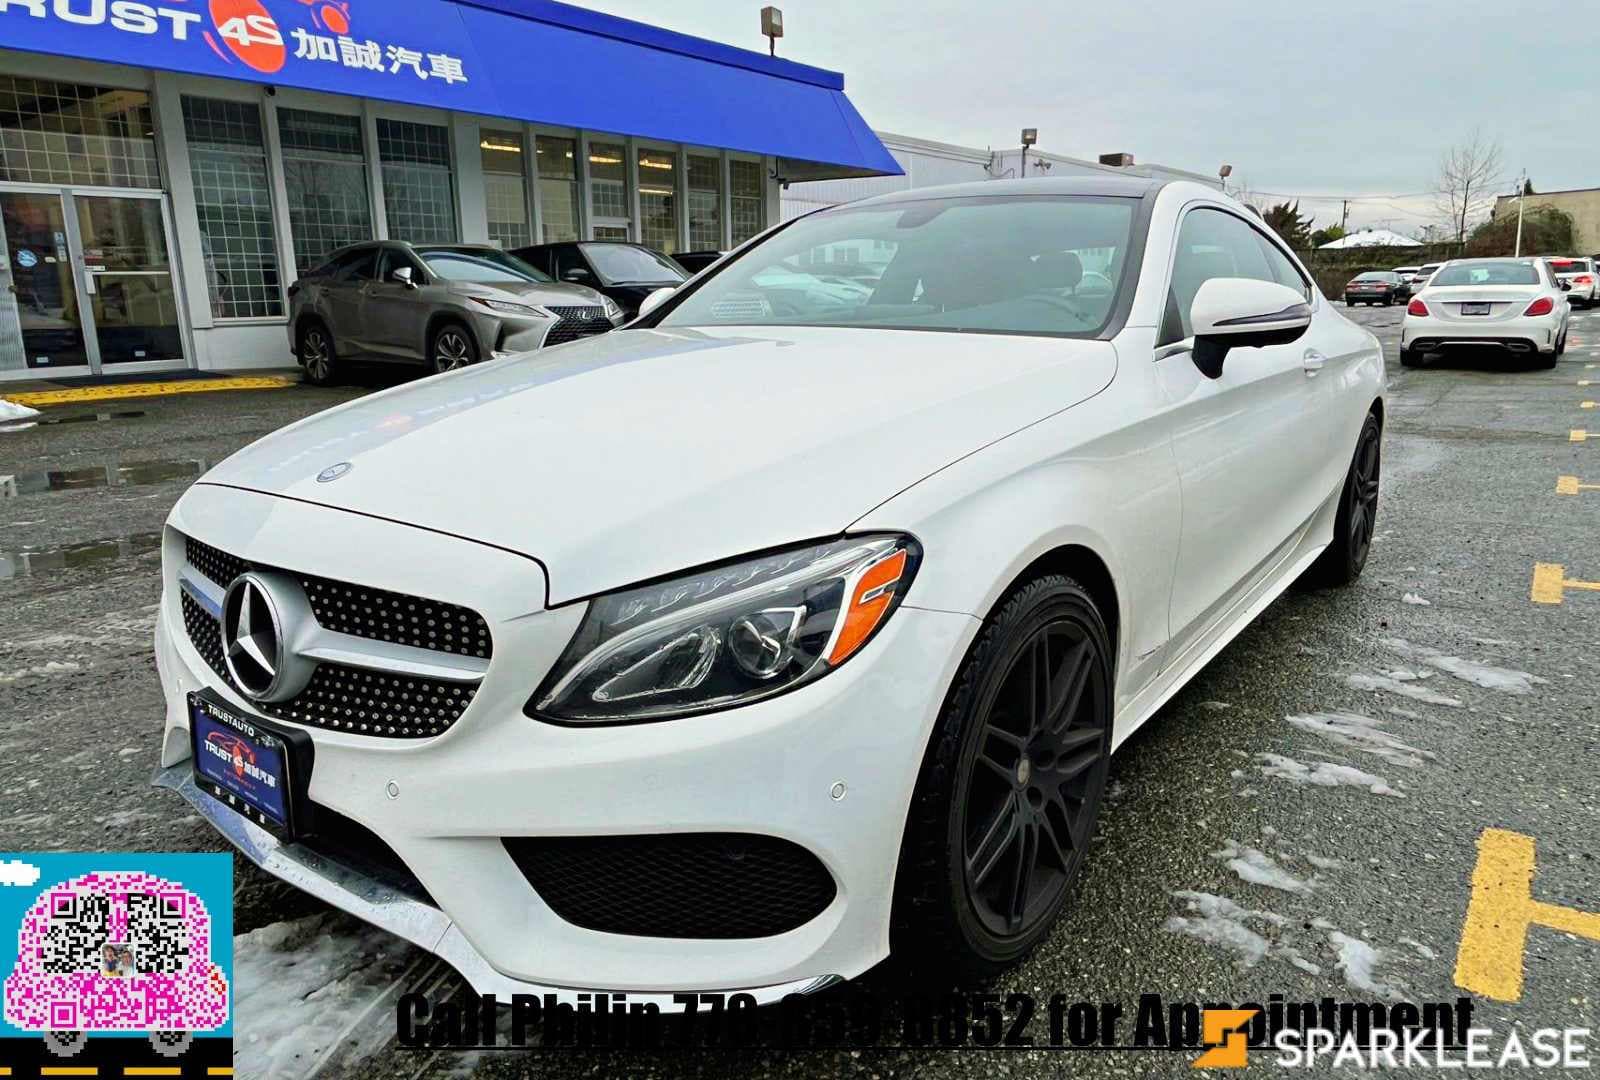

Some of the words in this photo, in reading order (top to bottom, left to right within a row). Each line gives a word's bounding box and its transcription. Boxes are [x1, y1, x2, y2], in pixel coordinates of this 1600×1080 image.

[217, 15, 285, 46] 4S
[290, 28, 468, 84] 加誠汽車
[208, 704, 255, 737] TRUSTAUTO
[204, 739, 233, 763] TRUST
